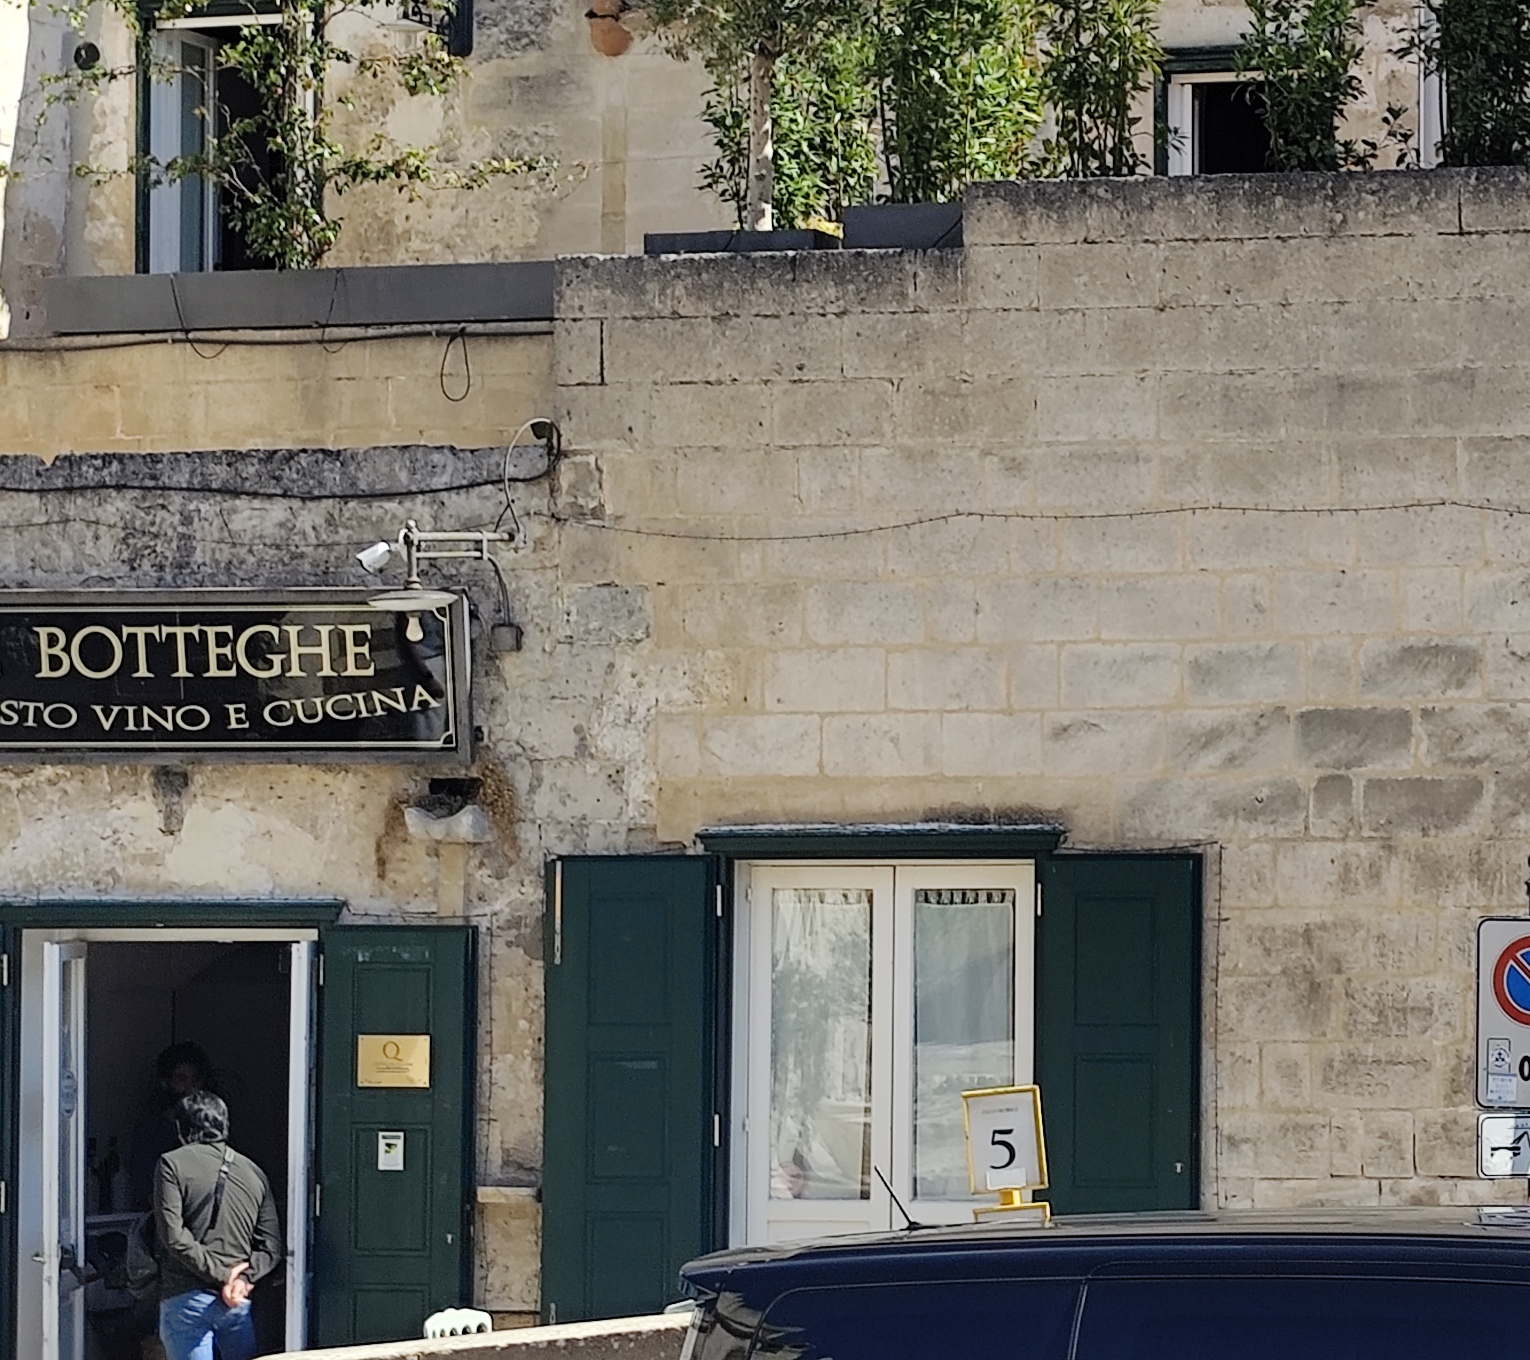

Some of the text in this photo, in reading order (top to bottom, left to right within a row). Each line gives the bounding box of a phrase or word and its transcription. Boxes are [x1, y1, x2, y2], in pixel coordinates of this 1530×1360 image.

[32, 623, 375, 679] BOTTEGHE
[90, 703, 211, 732] VINO
[226, 703, 250, 730] E
[263, 684, 441, 728] CUCINA
[382, 1040, 404, 1062] Q
[989, 1128, 1017, 1170] 5
